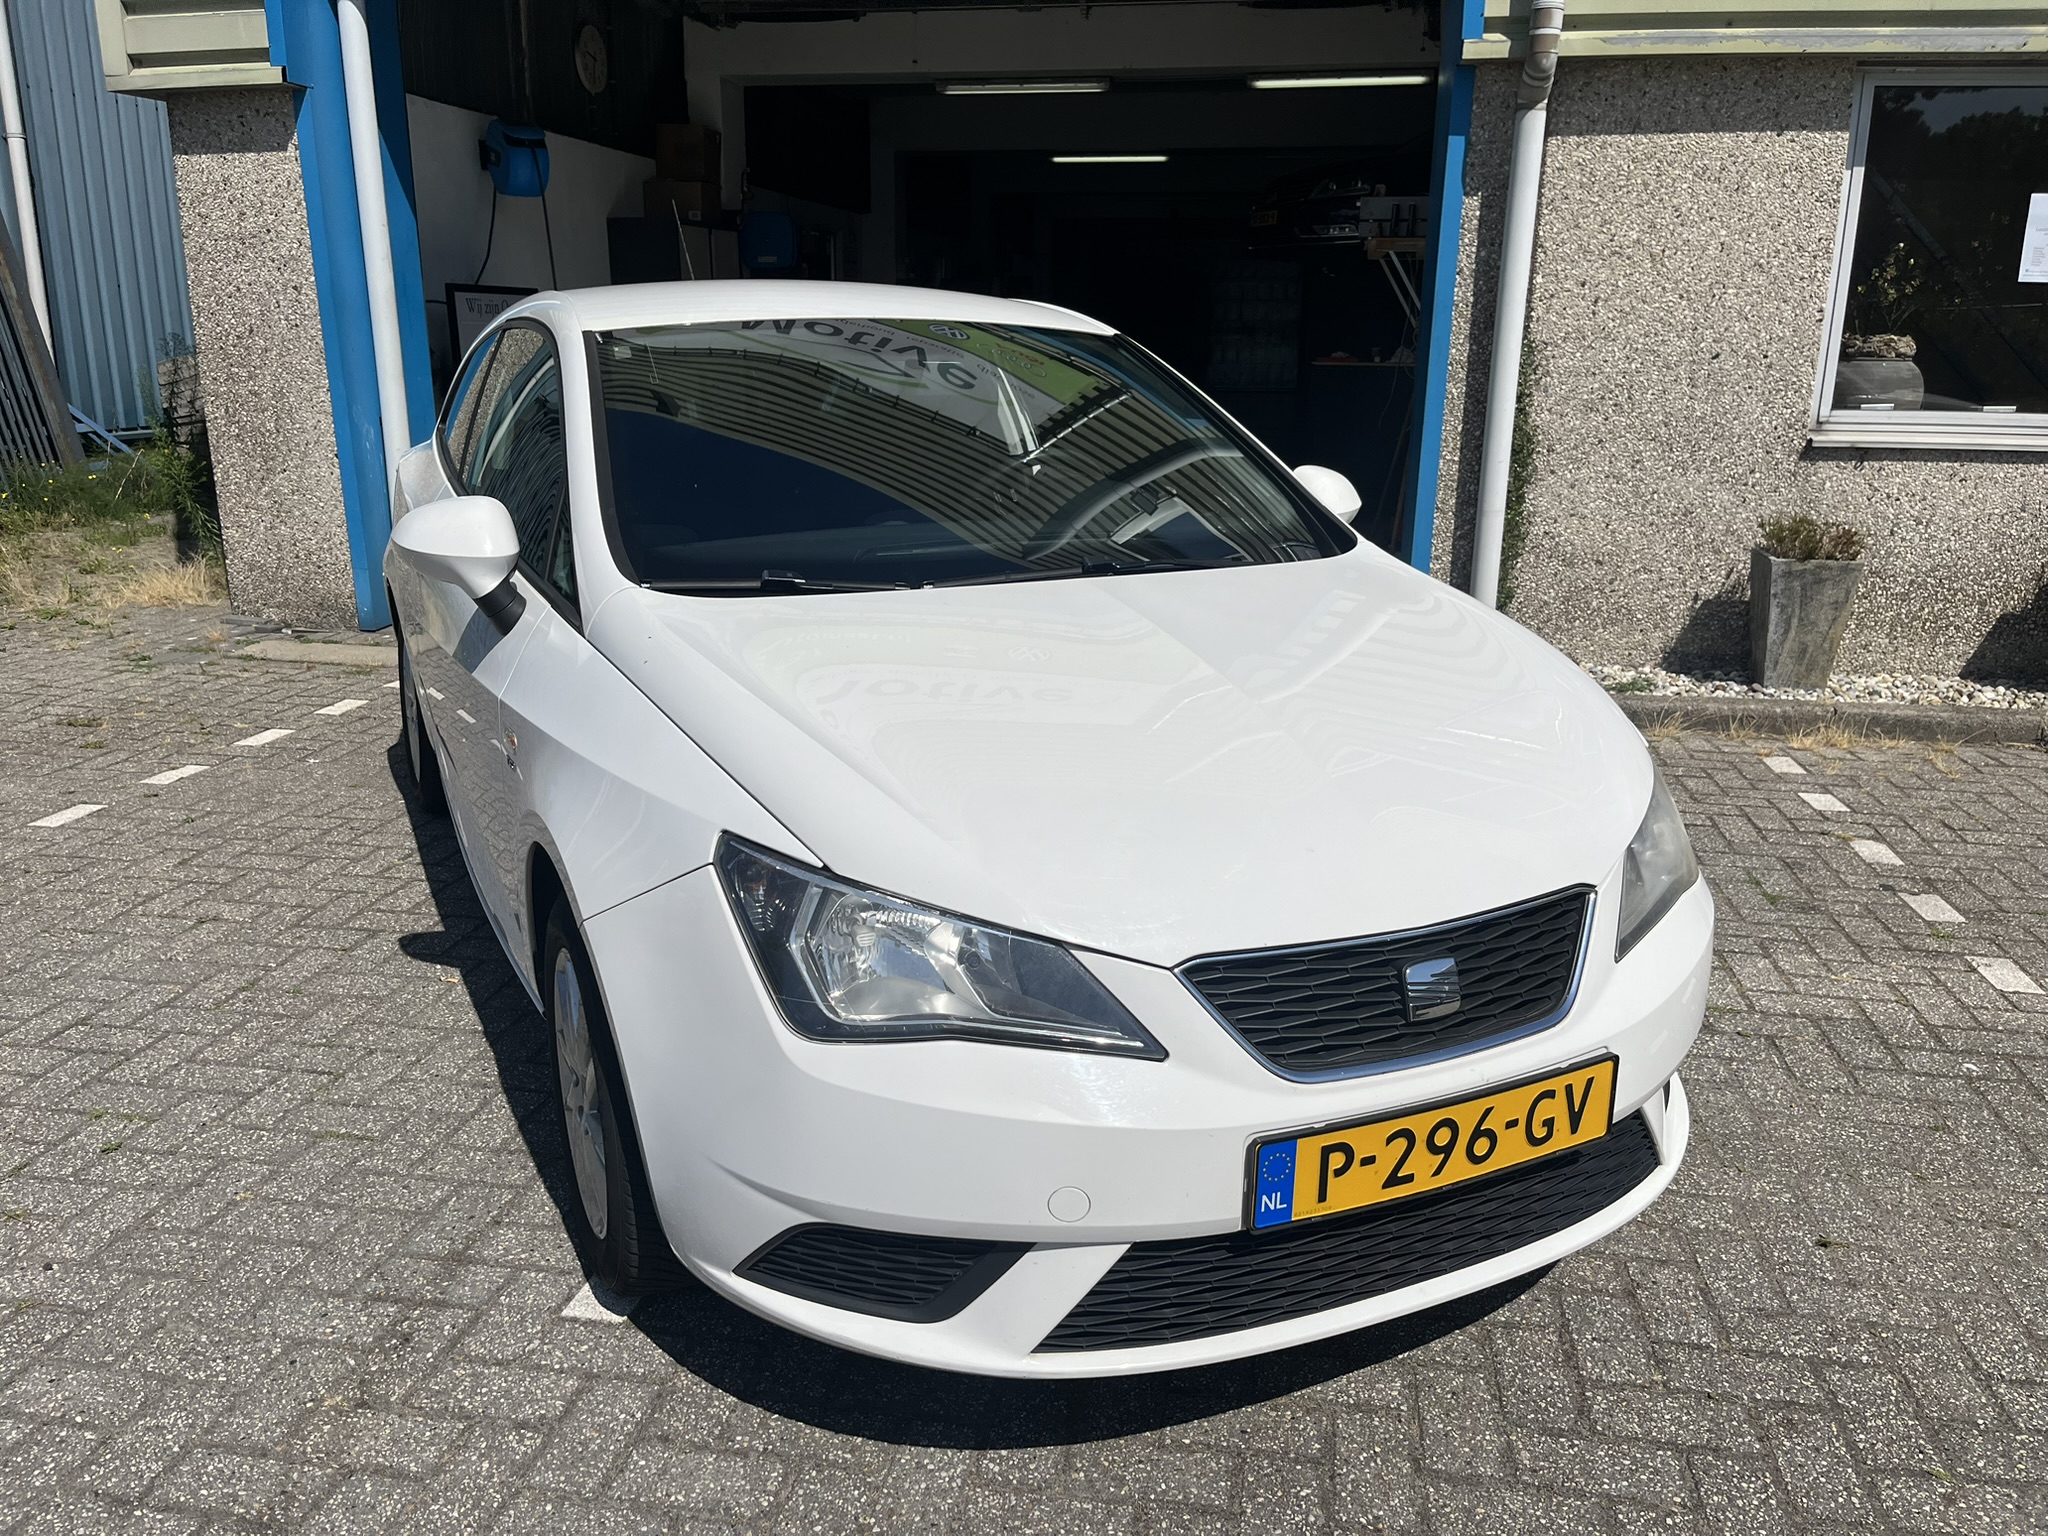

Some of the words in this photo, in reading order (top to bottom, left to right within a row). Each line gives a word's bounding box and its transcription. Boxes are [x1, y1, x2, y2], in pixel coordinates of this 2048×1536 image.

[465, 297, 482, 318] Wij
[484, 299, 500, 318] zijn
[1317, 1076, 1595, 1204] P-296-GV
[1260, 1192, 1288, 1213] NL
